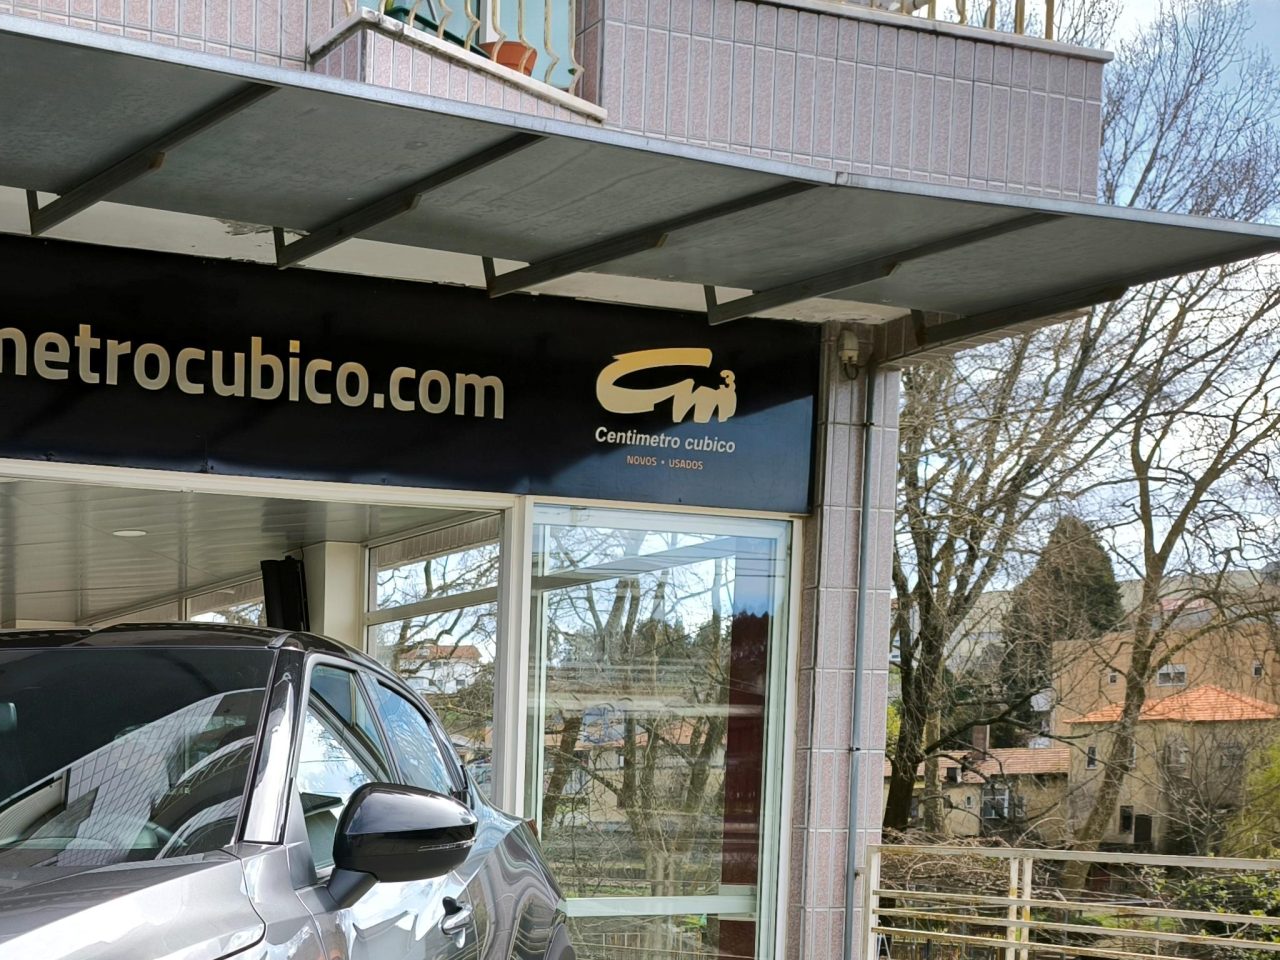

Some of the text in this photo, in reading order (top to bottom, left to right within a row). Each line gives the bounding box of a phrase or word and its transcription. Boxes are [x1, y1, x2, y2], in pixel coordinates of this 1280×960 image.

[595, 427, 736, 453] Centimetro cubico
[626, 456, 704, 470] NOVOS USADOS
